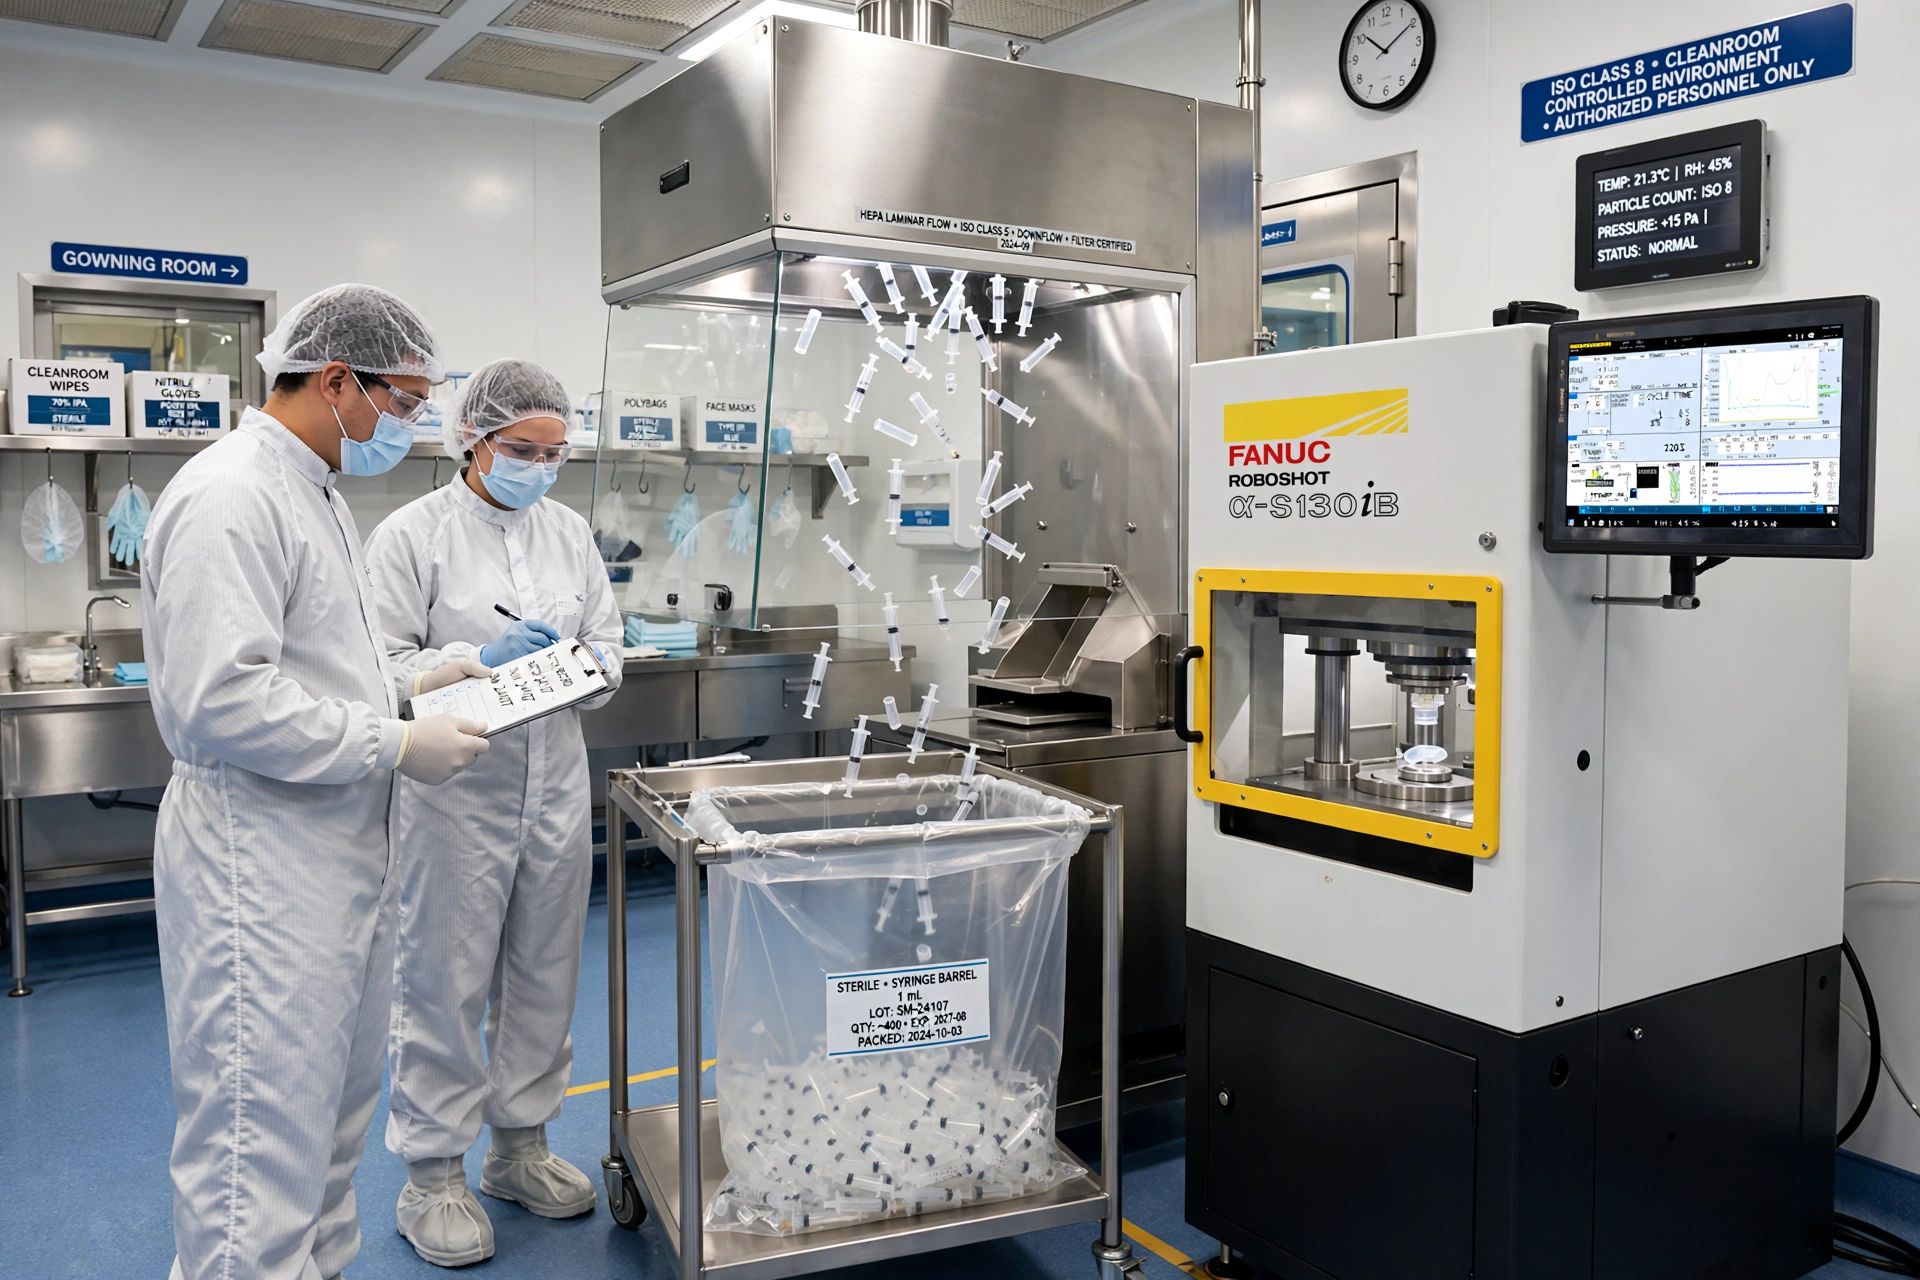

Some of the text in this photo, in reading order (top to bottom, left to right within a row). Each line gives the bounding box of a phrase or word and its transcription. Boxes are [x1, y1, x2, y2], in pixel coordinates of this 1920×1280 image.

[1381, 6, 1391, 18] 12
[1368, 17, 1375, 28] 11
[1410, 17, 1417, 28] 2
[1356, 33, 1366, 45] 10
[1415, 35, 1422, 47] 3
[1352, 54, 1359, 65] 9
[1411, 57, 1417, 67] 4
[1550, 25, 1780, 96] ISO CLASS 8 CLEANROOM
[1356, 73, 1363, 84] 8
[1399, 75, 1405, 86] 5
[1545, 45, 1782, 116] CONTROLLED ENVIRONMENT
[1368, 84, 1374, 95] 7
[1383, 85, 1389, 96] 6
[1554, 57, 1815, 132] AUTHORIZED PERSONNEL ONLY
[1597, 175, 1631, 193] TEMP:
[1684, 161, 1705, 178] RH:
[1707, 155, 1733, 172] 45%
[1598, 180, 1732, 216] PARTICLE COUNT: ISO 8
[860, 209, 1133, 252] HEPA LAMINAR FLOW ISO CLASS 5 DOWNFLOW FILTER CERTIFIED
[1597, 218, 1658, 239] PRESSURE:
[1661, 213, 1681, 228] +15
[1597, 235, 1698, 263] STATUS: NORMAL
[62, 250, 217, 277] GOWNING ROOM
[27, 366, 109, 380] CLEANROOM
[49, 380, 90, 392] WIPES
[161, 388, 201, 398] GLOVES
[624, 398, 668, 408] POLYBAGS
[706, 402, 757, 413] FACE MASKS
[1228, 440, 1331, 467] FANUC
[1228, 471, 1331, 487] ROBOSHOT
[837, 969, 978, 993] STERILE SYRINGE BARREL
[897, 990, 922, 1001] 1 mL
[869, 1000, 949, 1019] LOT: SM-24107
[850, 1021, 876, 1034] QTY:
[857, 1025, 962, 1048] PACKED: 2024-10-03
